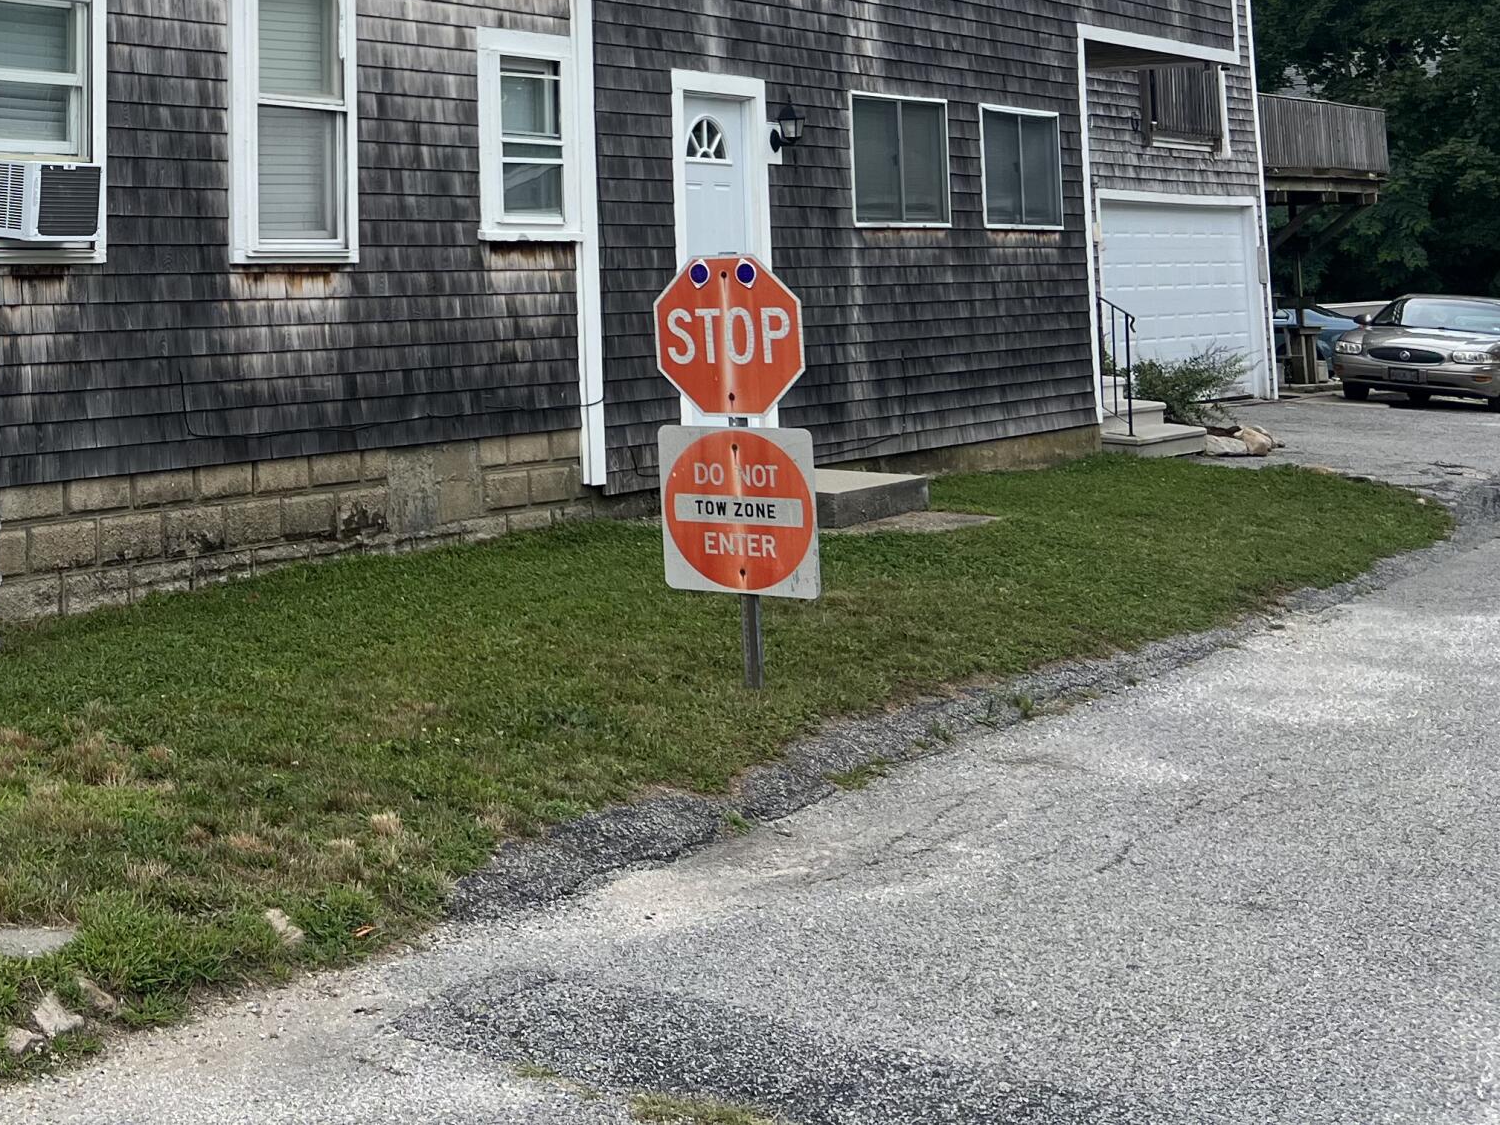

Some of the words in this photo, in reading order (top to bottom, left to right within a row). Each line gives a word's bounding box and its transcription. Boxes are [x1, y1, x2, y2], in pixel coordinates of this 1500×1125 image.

[667, 306, 790, 365] STOP
[694, 462, 724, 486] DO
[735, 464, 778, 488] NOT
[695, 499, 726, 516] TOW
[733, 502, 776, 519] ZONE
[704, 531, 776, 559] ENTER
